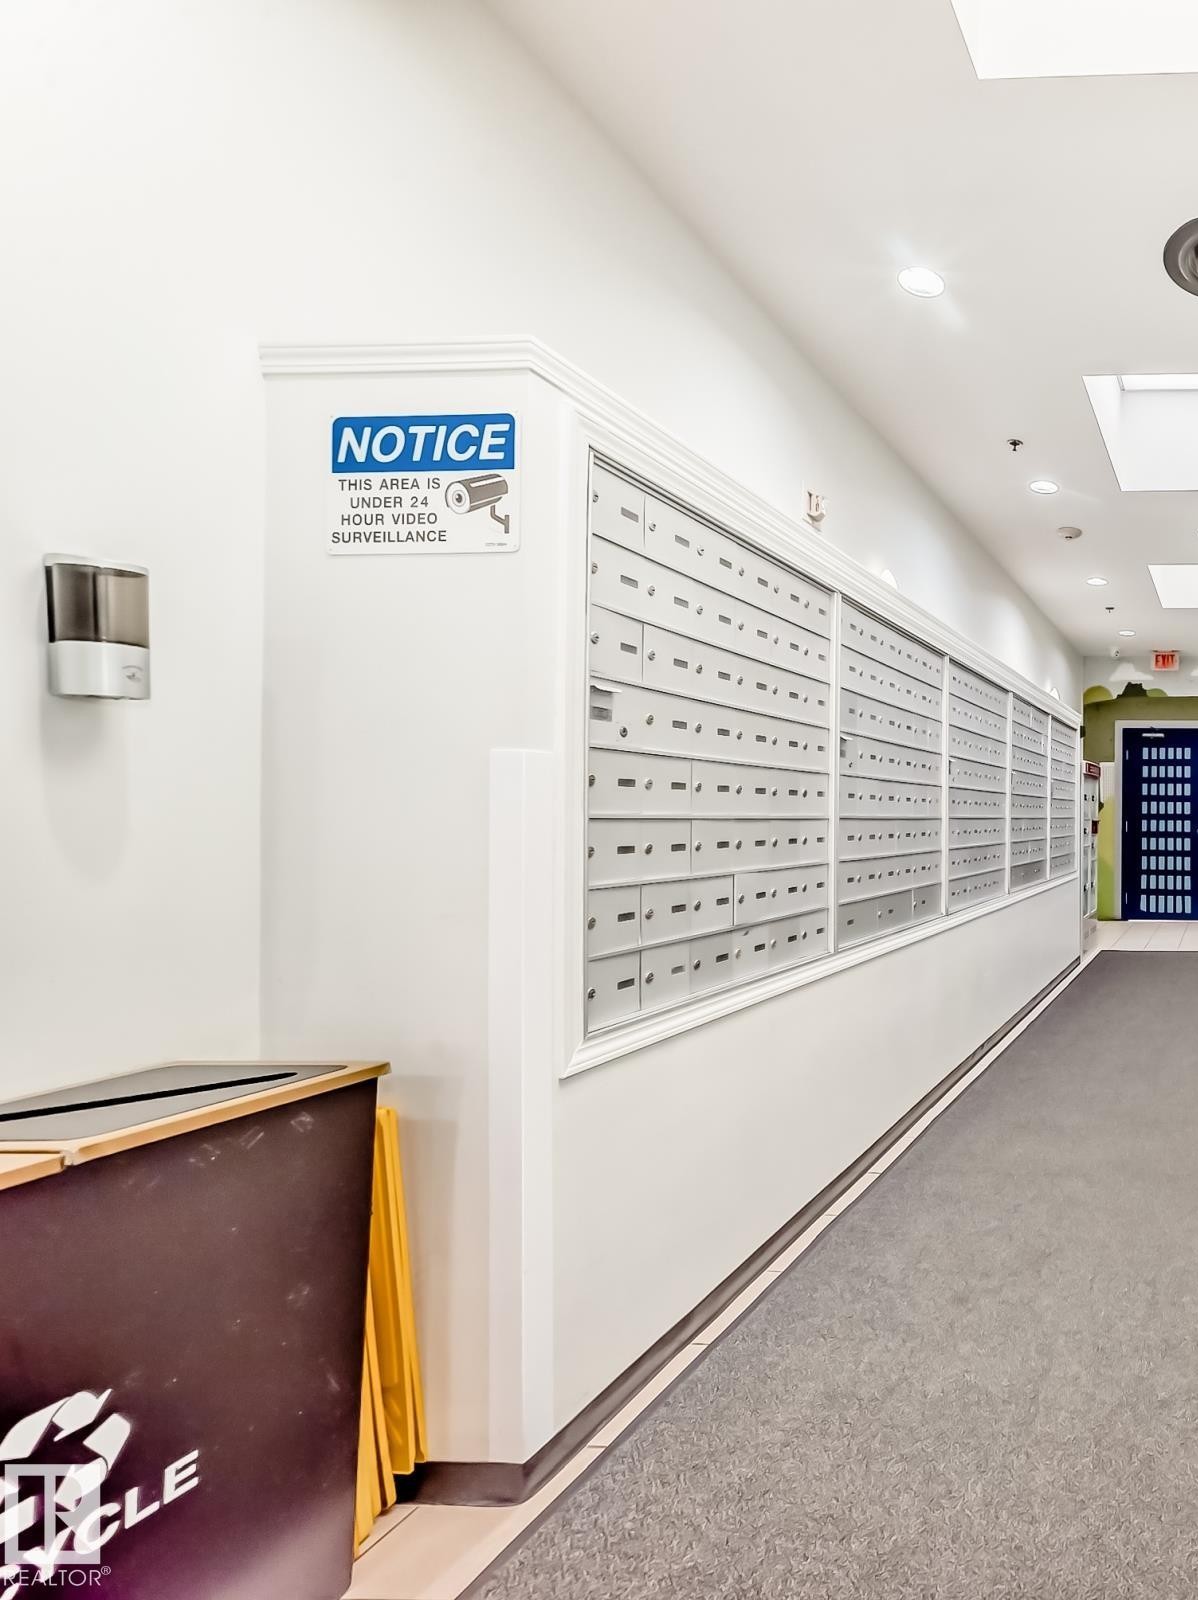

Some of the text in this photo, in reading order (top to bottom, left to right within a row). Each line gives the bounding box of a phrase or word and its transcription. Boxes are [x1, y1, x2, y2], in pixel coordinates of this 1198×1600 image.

[337, 424, 510, 463] NOTICE
[338, 477, 441, 491] THIS AREA IS
[350, 496, 429, 509] UNDER 24
[341, 512, 438, 526] HOUR VIDEO
[331, 530, 447, 544] SURVEILLANCE
[1154, 654, 1176, 668] EXIT
